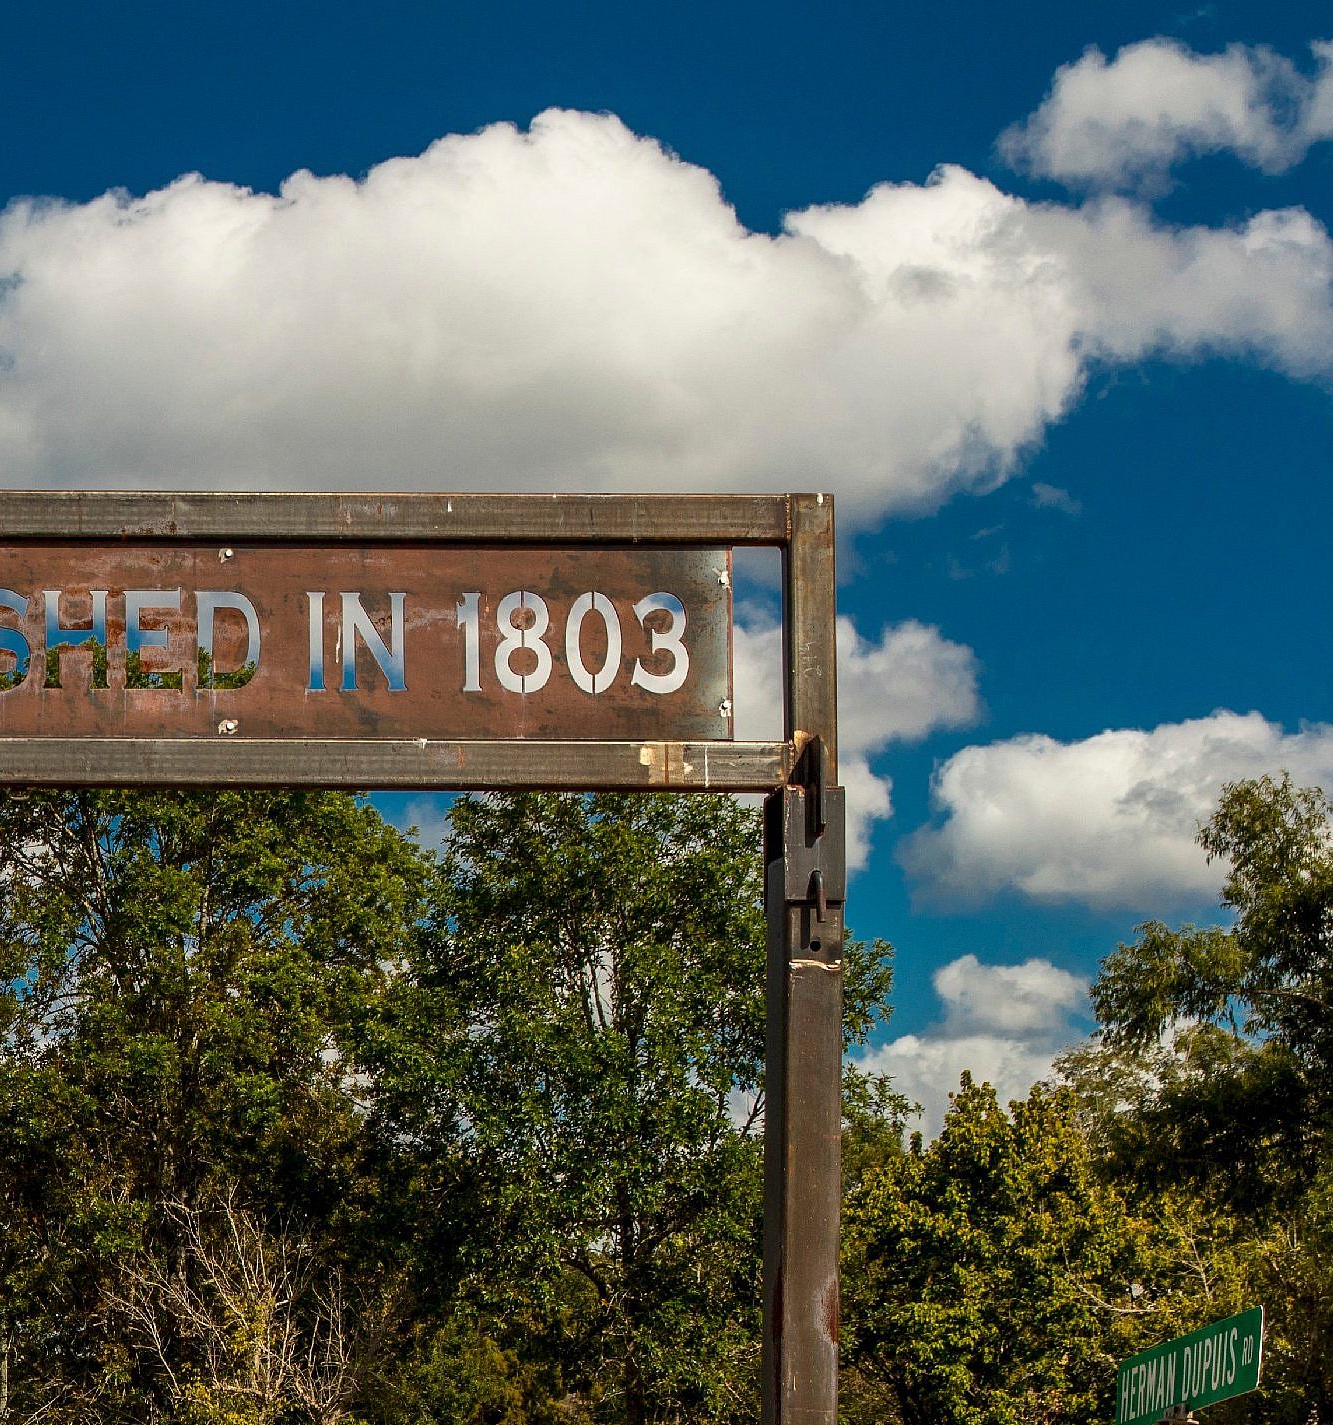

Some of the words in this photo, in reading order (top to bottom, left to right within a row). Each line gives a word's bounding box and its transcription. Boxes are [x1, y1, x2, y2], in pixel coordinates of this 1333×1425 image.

[304, 591, 408, 692] IN
[456, 590, 690, 695] 1803
[1120, 1351, 1177, 1424] HERMAN
[1181, 1327, 1238, 1402] DUPUIS
[1241, 1334, 1254, 1366] RD
